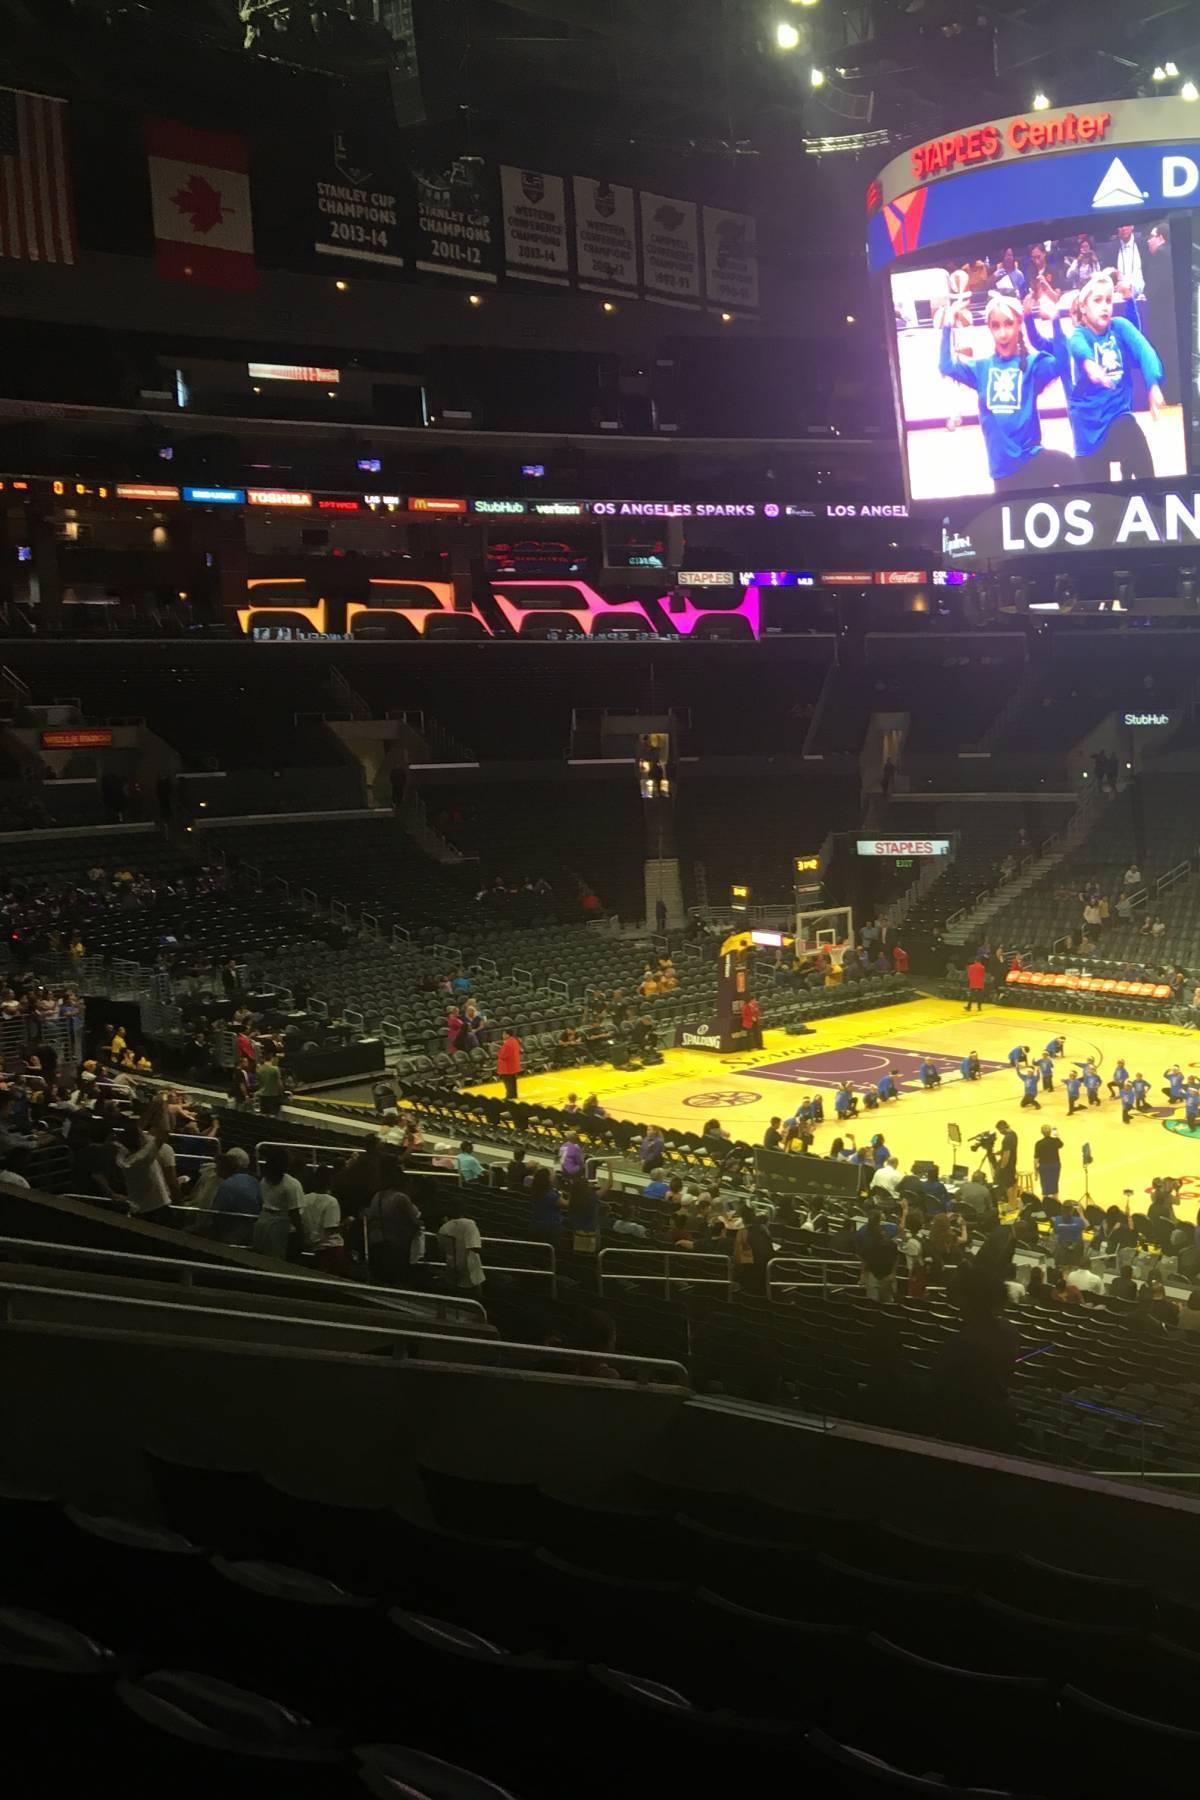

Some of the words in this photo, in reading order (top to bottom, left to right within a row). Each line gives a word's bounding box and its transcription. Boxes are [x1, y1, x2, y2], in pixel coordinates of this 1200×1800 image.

[911, 124, 1002, 178] STAPLES
[1008, 113, 1111, 151] Center
[317, 181, 368, 204] STANLEY
[371, 192, 396, 209] CUP
[319, 198, 397, 225] CHAMPIONS
[329, 222, 388, 248] 2013-14
[420, 216, 491, 243] CHAMPIONS
[431, 240, 481, 264] 2011-12
[250, 492, 310, 506] TOSHIBA
[475, 501, 524, 514] StubHub
[536, 503, 581, 515] verizon
[593, 502, 616, 515] OS
[620, 503, 692, 517] ANGELES
[696, 504, 755, 517] SPARKS
[827, 505, 856, 517] LOS
[860, 505, 909, 518] ANGEL
[1001, 498, 1095, 551] LOS
[679, 571, 732, 585] STAPLES
[932, 570, 948, 578] COL
[1124, 713, 1169, 725] StubHub
[874, 842, 933, 855] STAPLES
[896, 859, 912, 868] EXIT
[682, 1032, 721, 1050] SPALDING
